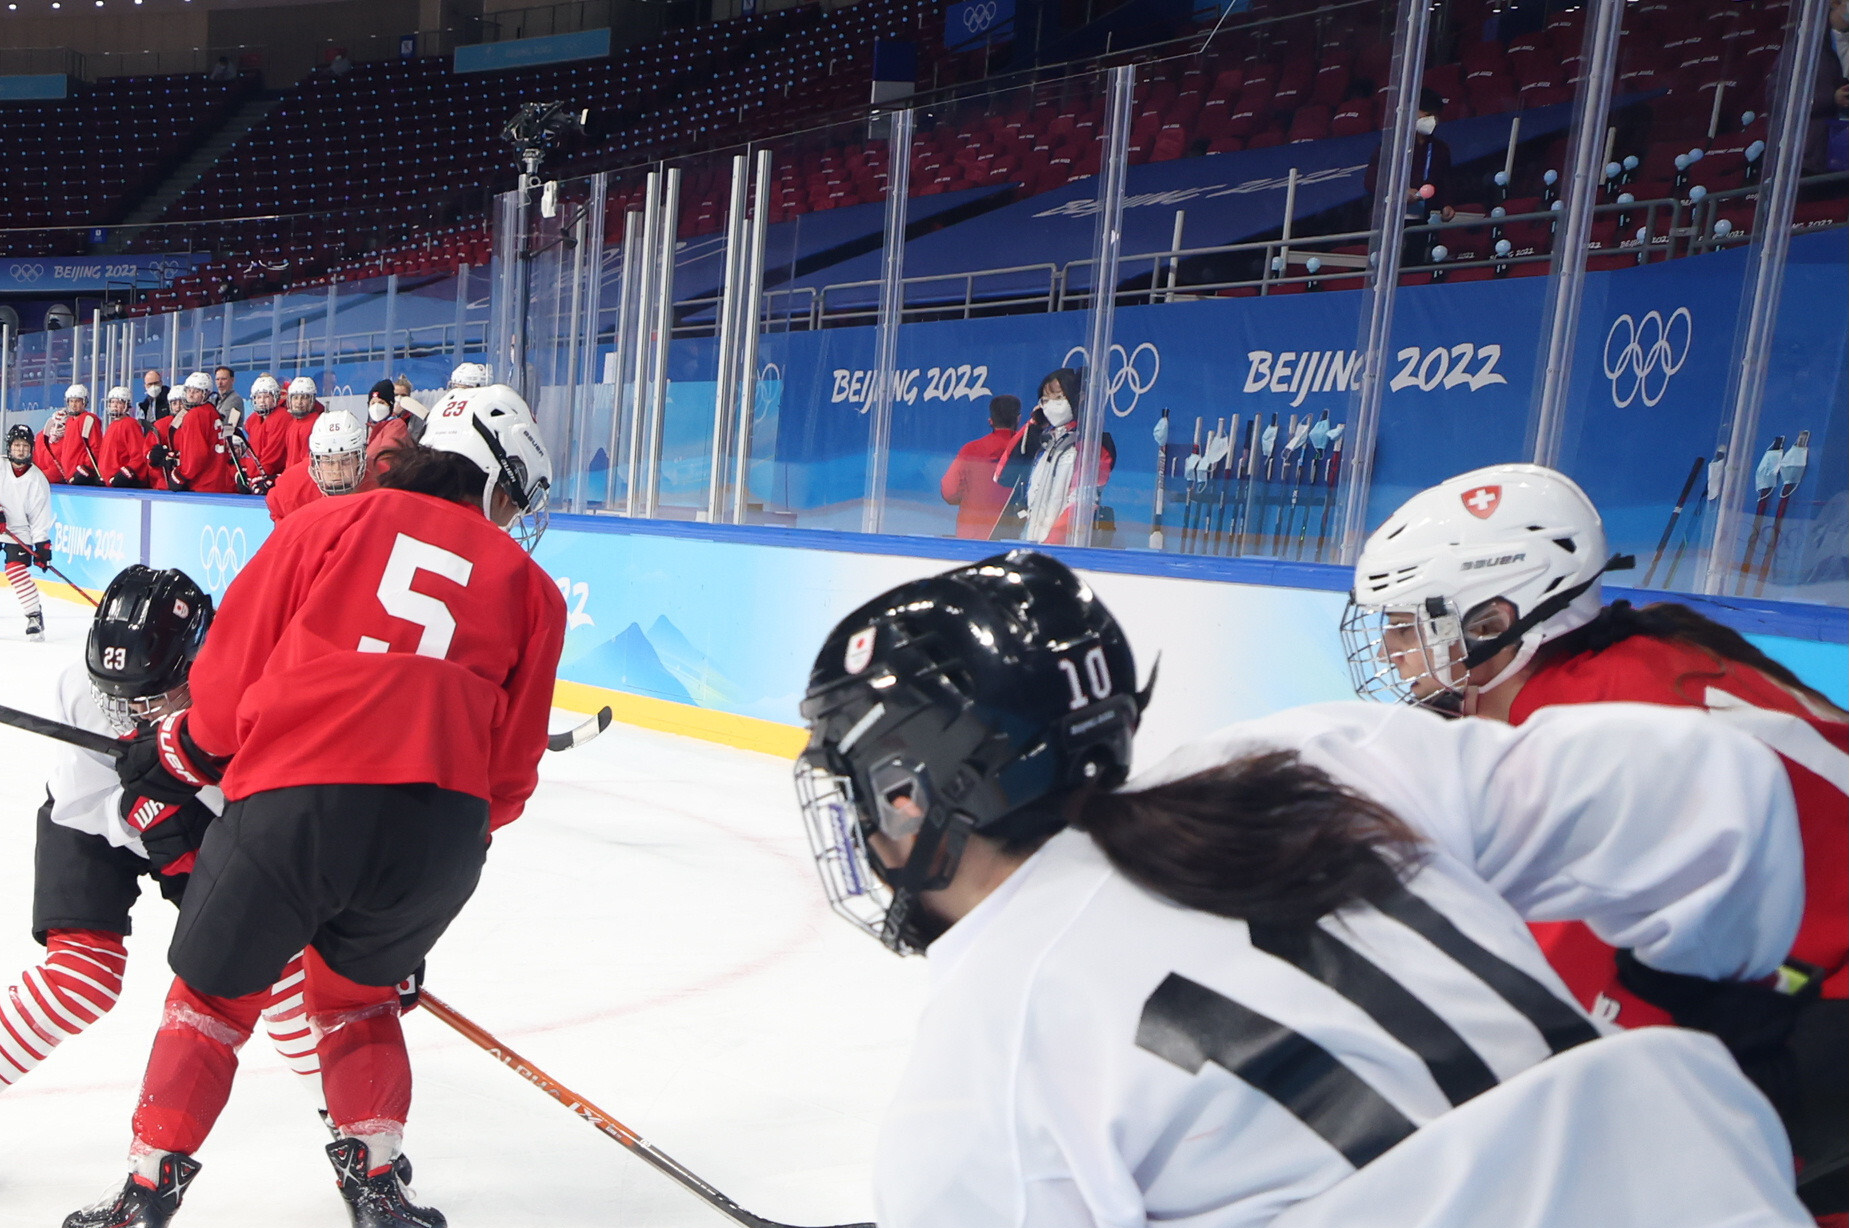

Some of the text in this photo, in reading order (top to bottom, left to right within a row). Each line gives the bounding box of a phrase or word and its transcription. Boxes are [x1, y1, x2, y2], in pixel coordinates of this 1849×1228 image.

[54, 264, 138, 283] BEIJING 2022
[923, 365, 993, 402] 2022
[1390, 343, 1508, 393] 2022
[523, 430, 544, 457] BAUER
[55, 522, 92, 564] BEIJING
[1460, 553, 1526, 571] BAUER
[357, 532, 474, 660] 5
[103, 647, 126, 670] 23
[1057, 646, 1113, 710] 10
